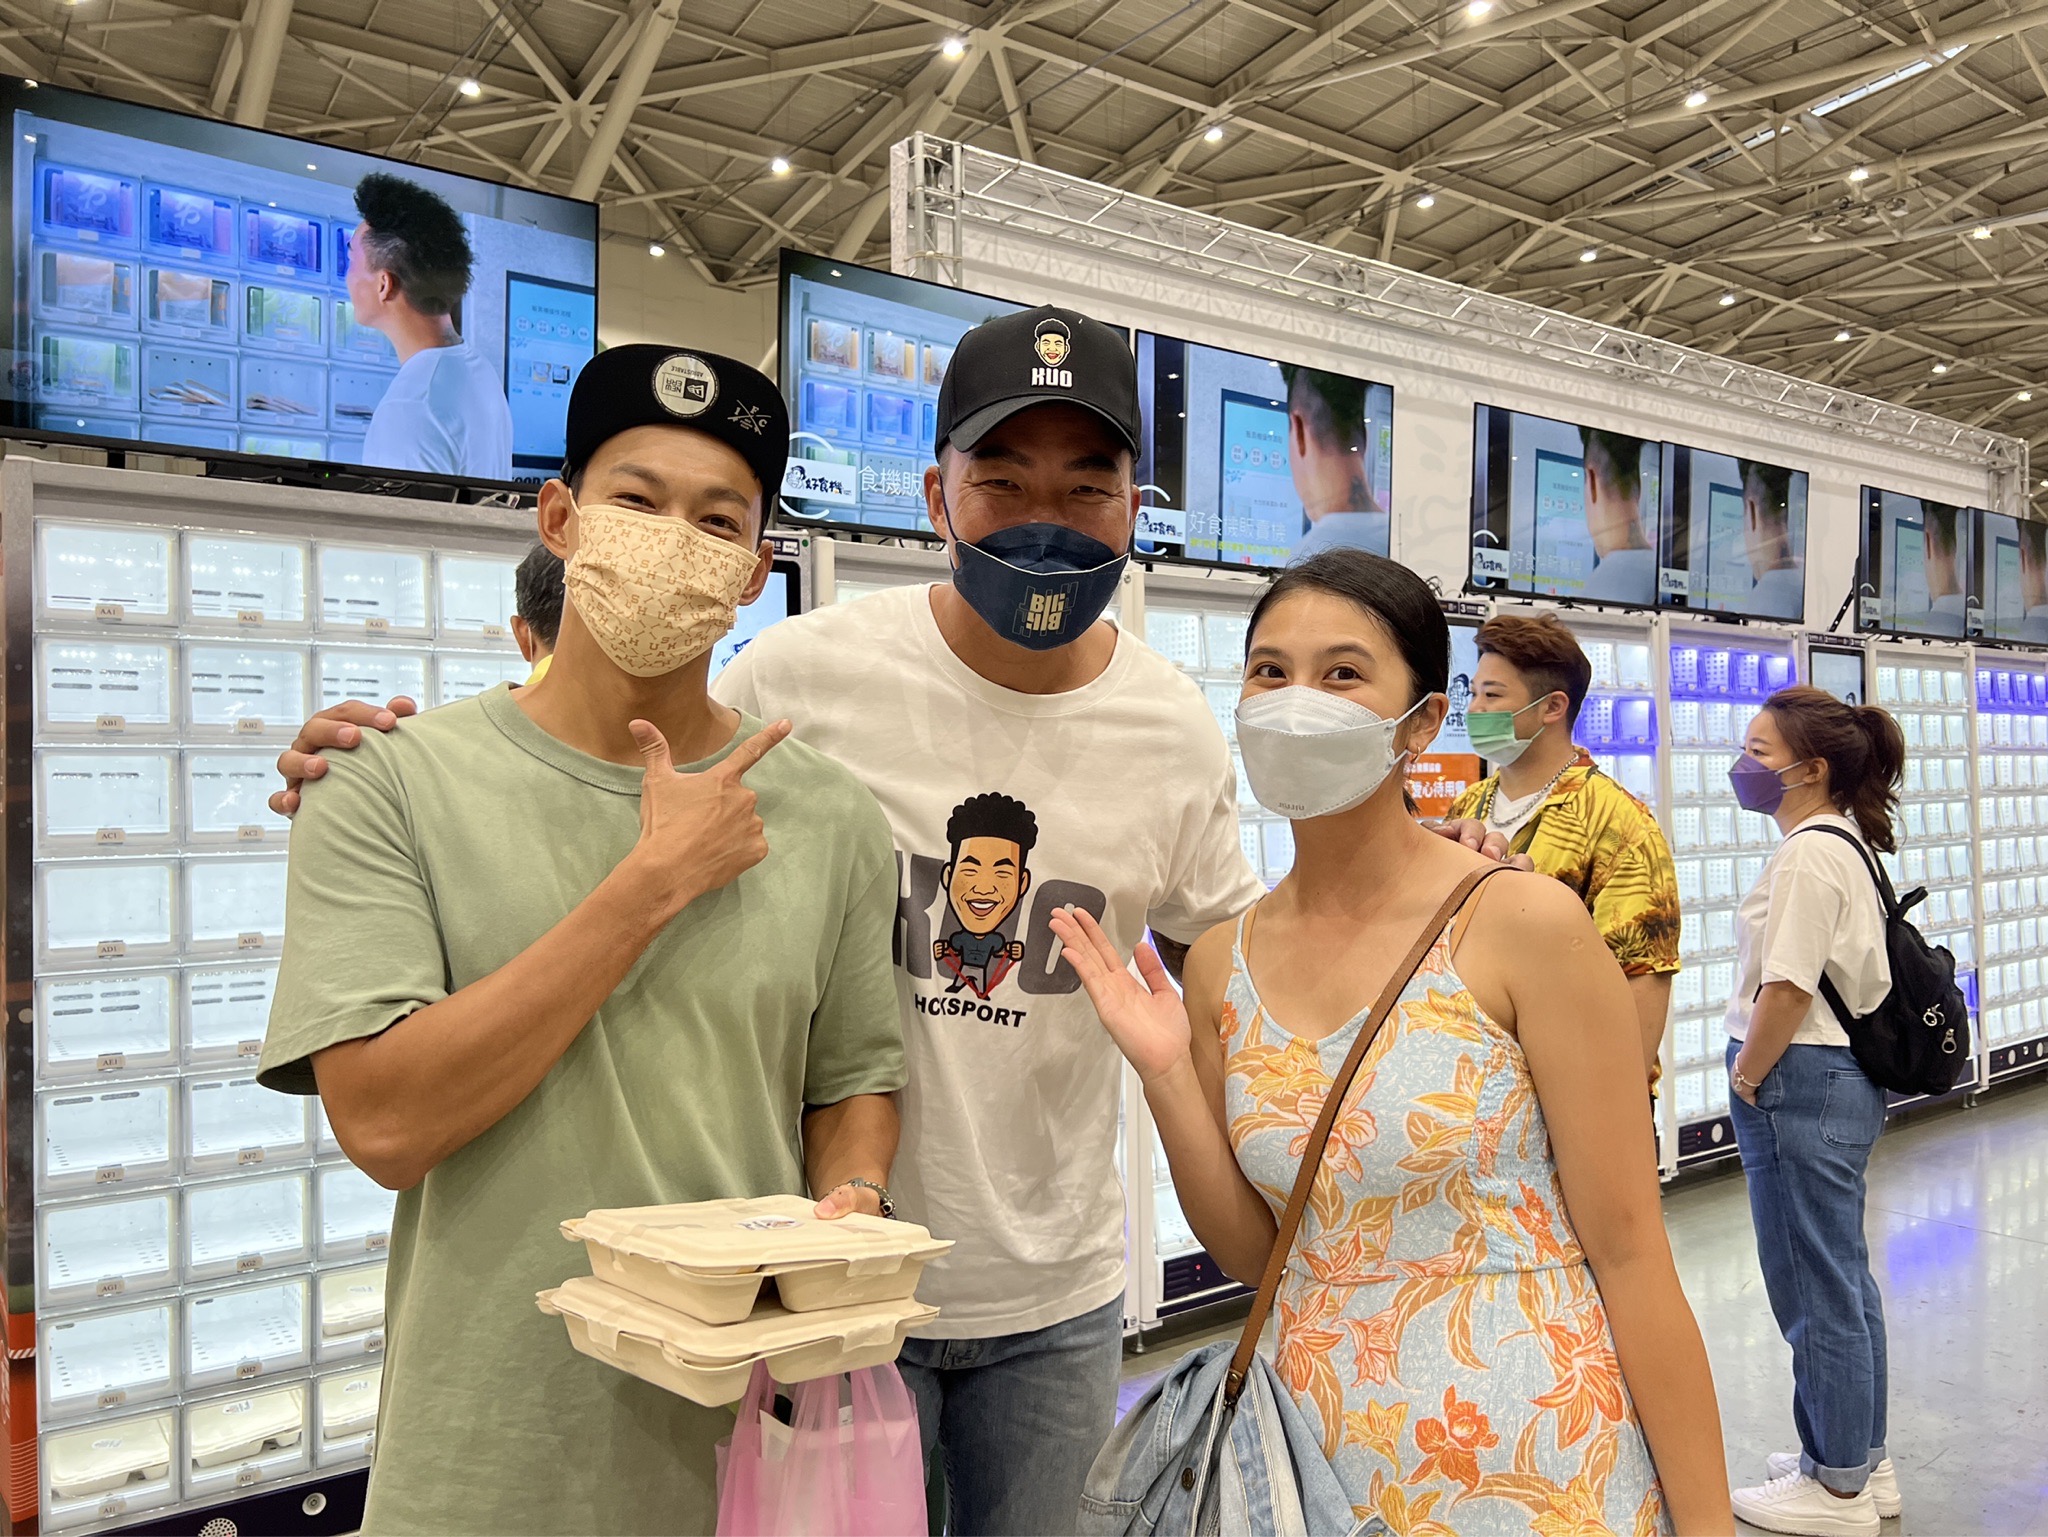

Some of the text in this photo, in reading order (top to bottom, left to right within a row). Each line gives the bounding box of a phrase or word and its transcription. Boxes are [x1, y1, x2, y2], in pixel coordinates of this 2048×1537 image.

[671, 365, 704, 378] ADJUSTABLE
[1031, 367, 1073, 388] KUO
[664, 384, 683, 394] NEW
[665, 377, 683, 387] ERA
[805, 475, 843, 495] 好食機
[858, 465, 924, 499] 食機販
[1446, 712, 1466, 727] 好食
